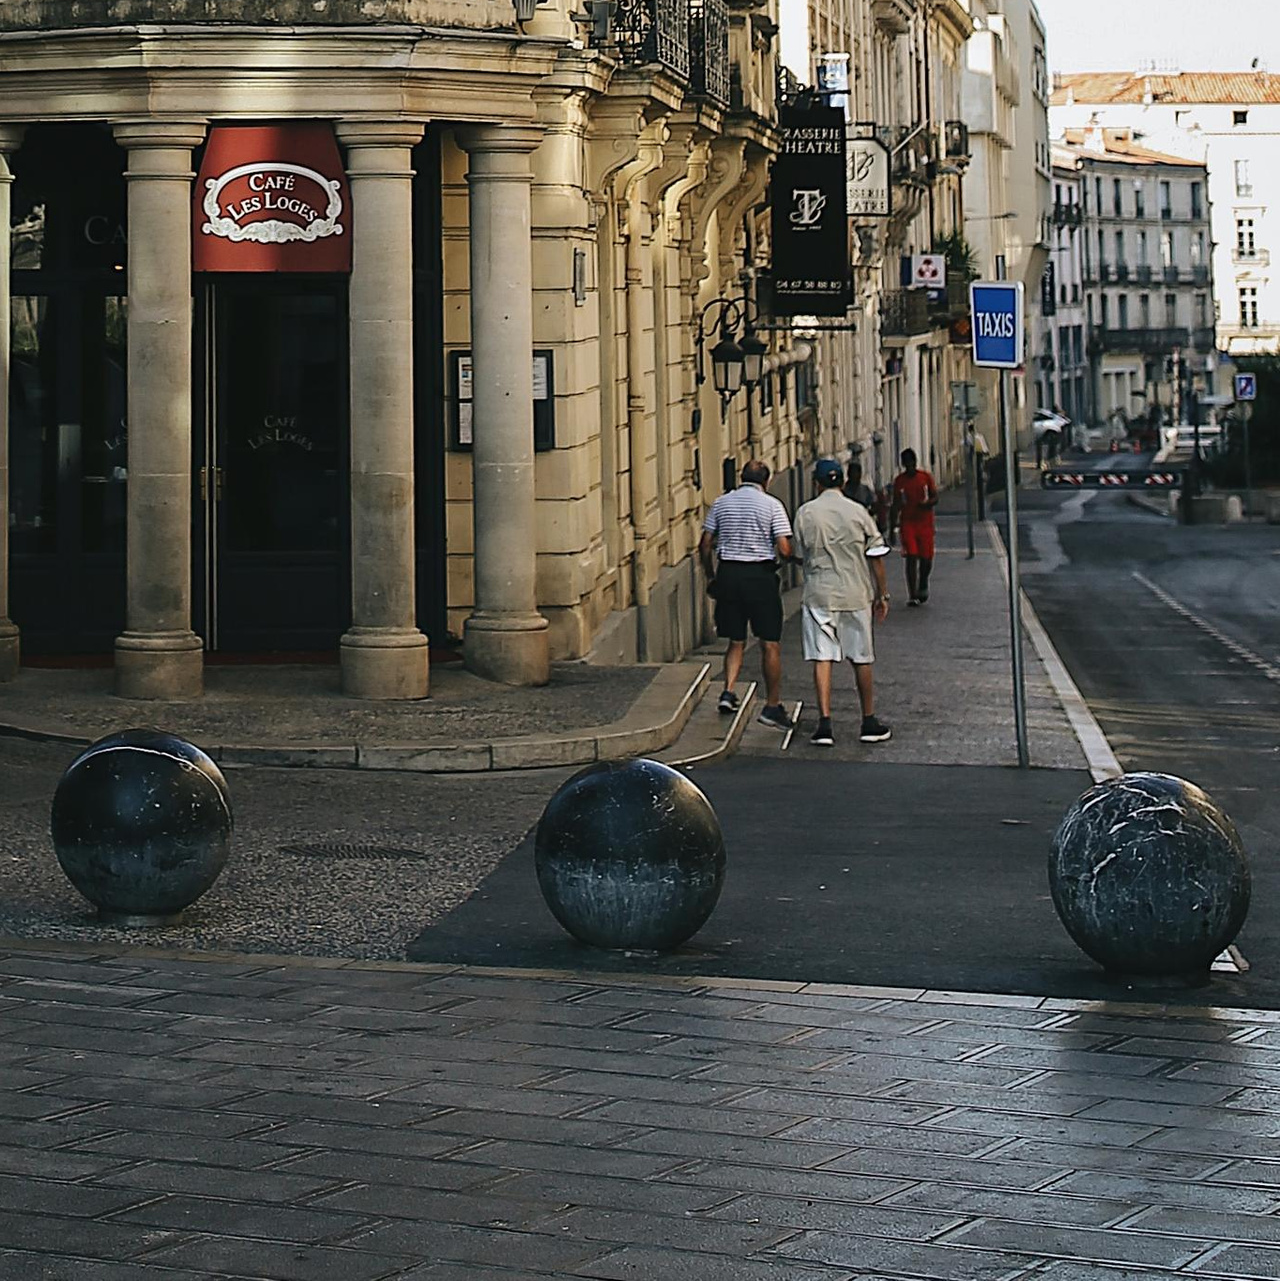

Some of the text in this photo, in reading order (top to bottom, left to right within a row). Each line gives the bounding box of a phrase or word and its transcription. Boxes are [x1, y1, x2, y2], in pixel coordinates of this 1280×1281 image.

[782, 127, 841, 140] RASSERIE
[249, 173, 295, 191] CAFÉ
[226, 192, 318, 222] LES LOGES
[976, 311, 1013, 338] TAXIS
